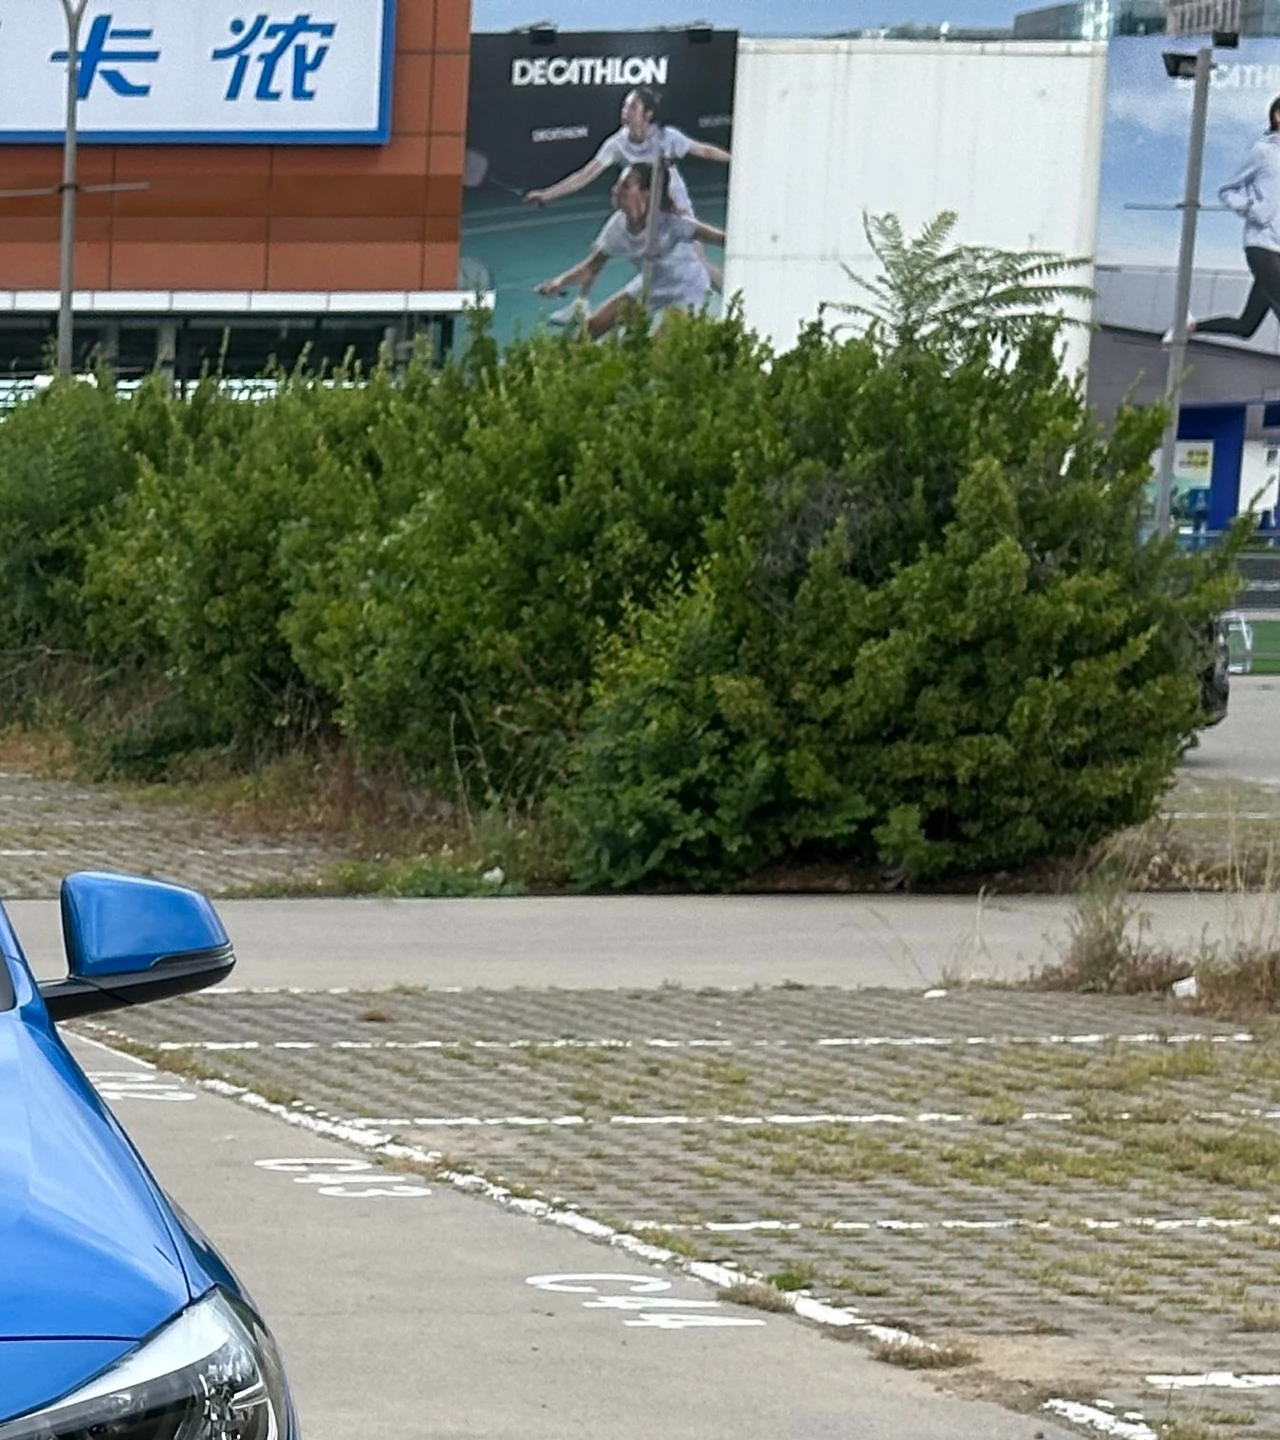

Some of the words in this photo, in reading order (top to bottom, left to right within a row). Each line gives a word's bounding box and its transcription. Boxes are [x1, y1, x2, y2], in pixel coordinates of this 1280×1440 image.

[511, 56, 669, 86] DECATHLON
[254, 1157, 432, 1198] C43
[525, 1273, 767, 1329] C44
